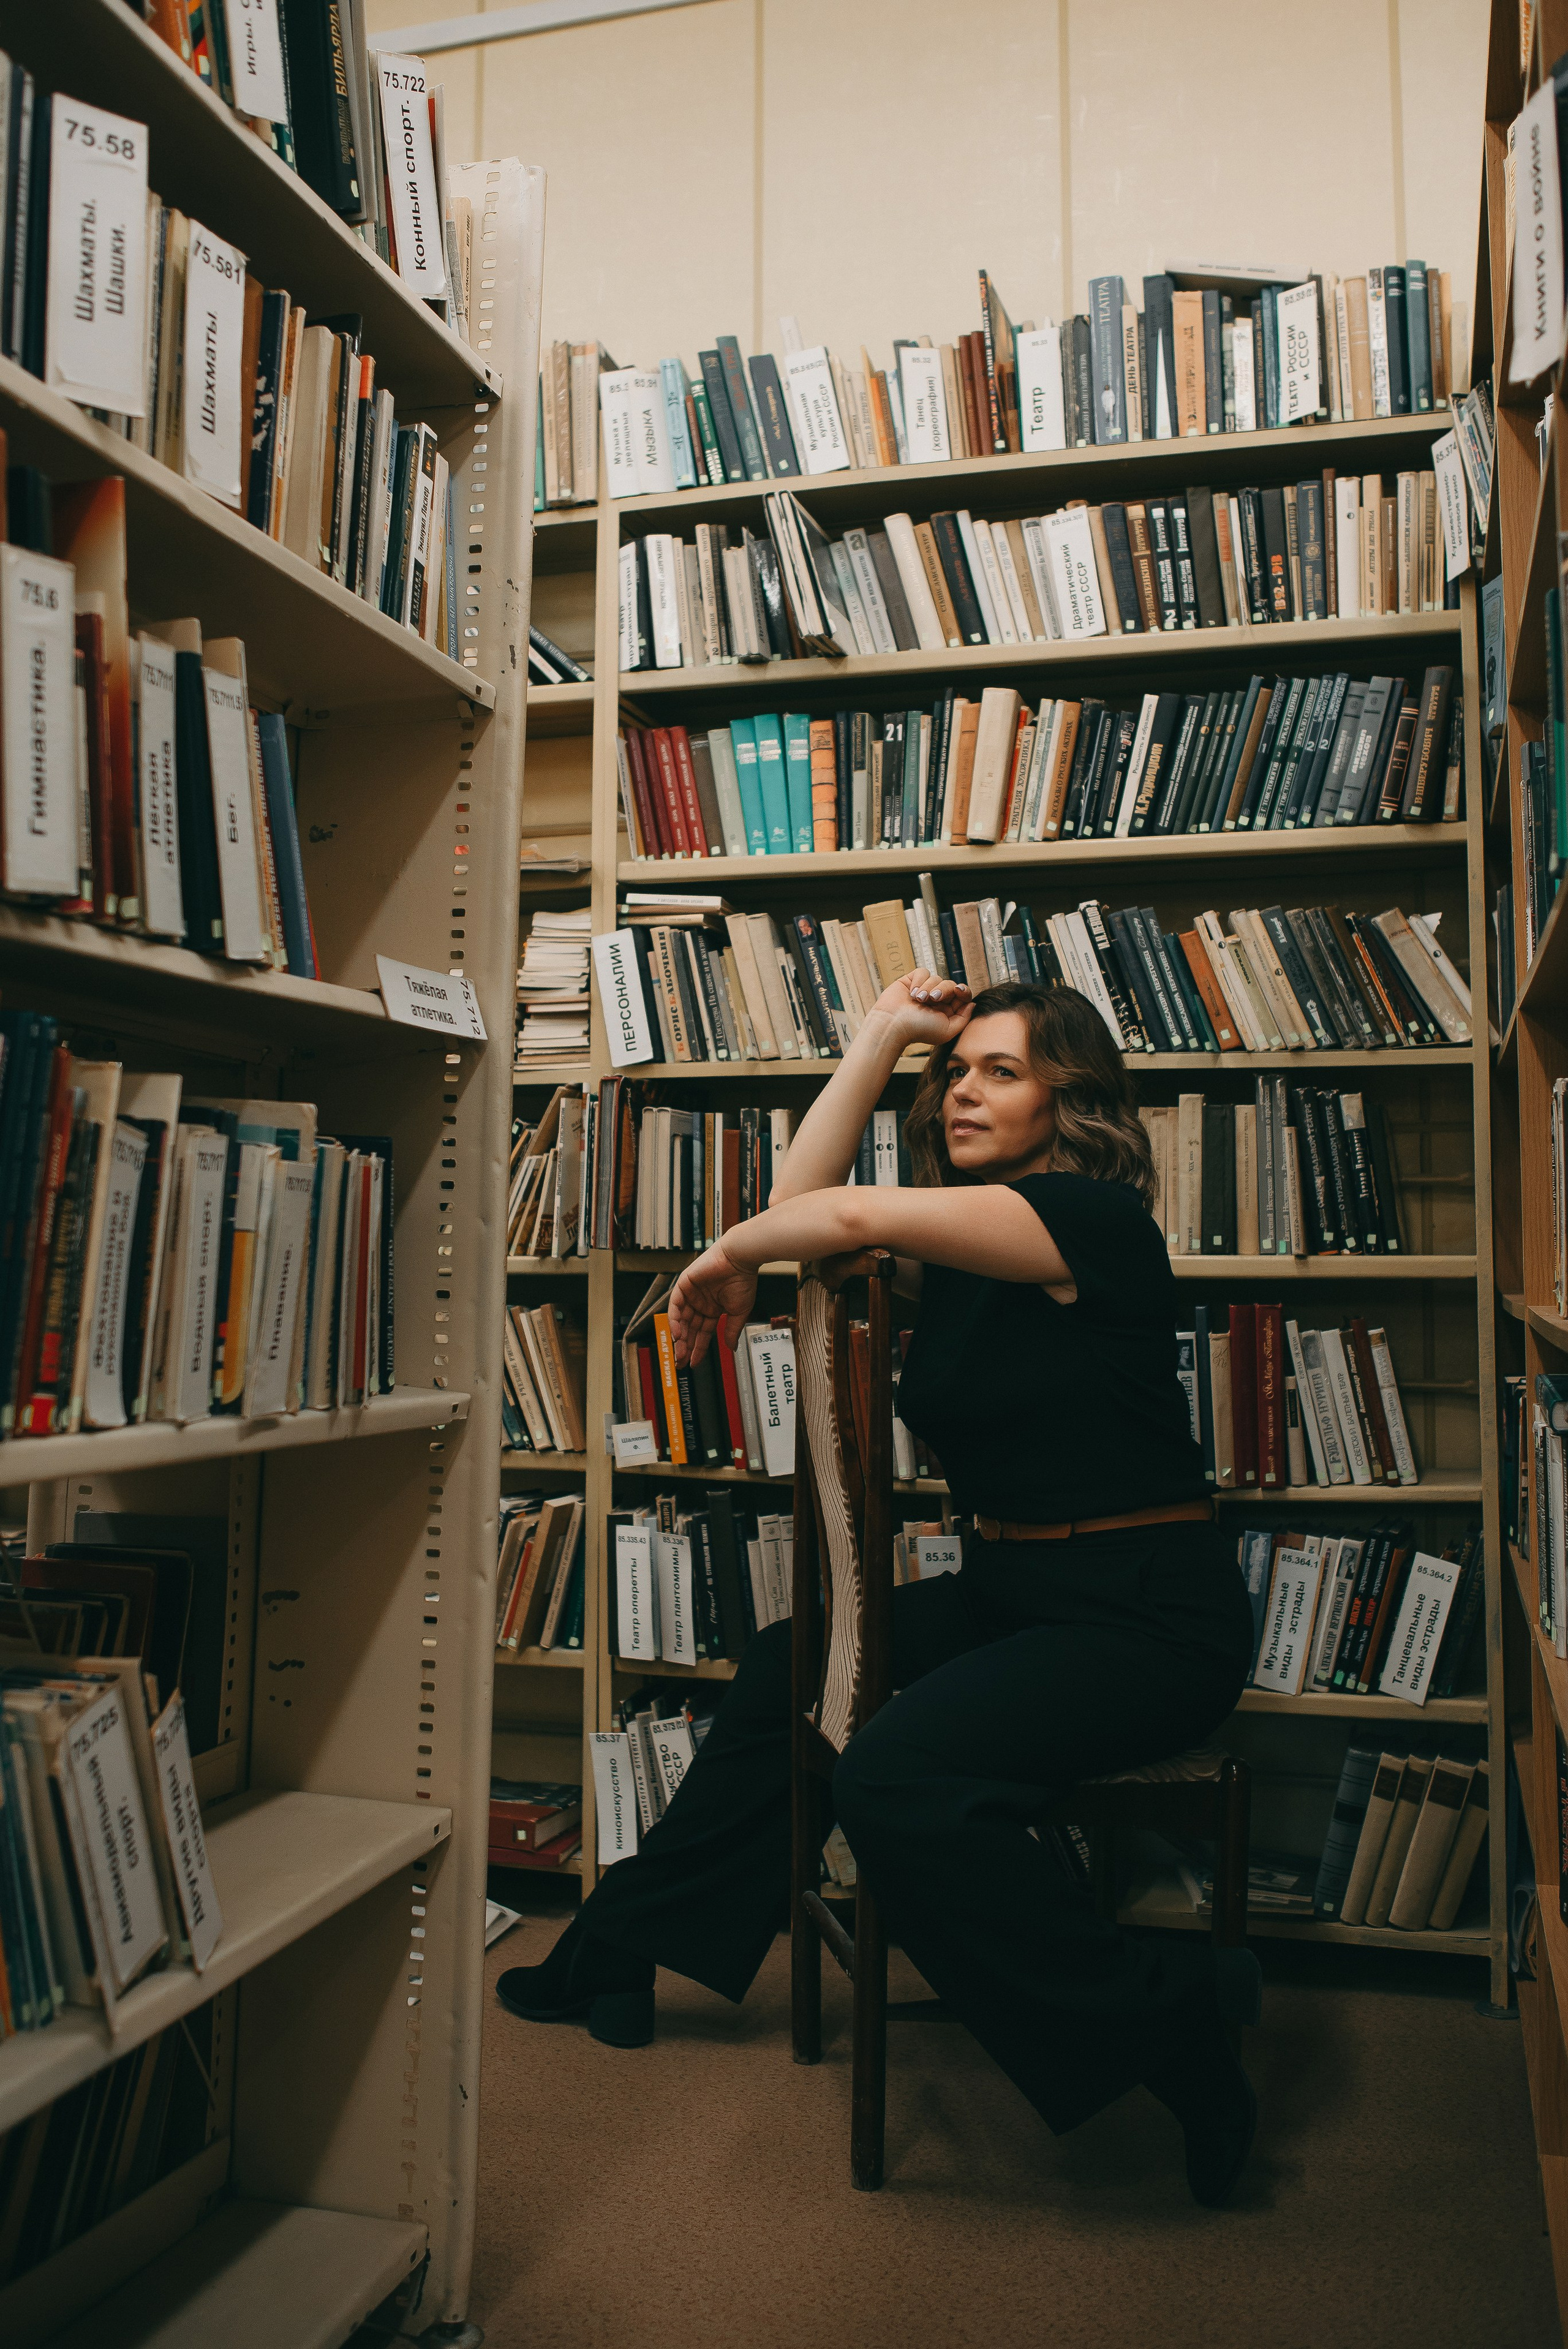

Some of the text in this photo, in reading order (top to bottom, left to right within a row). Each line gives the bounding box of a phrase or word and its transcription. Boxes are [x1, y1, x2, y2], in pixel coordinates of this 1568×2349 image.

[329, 4, 349, 97] БИЛЬЯРДА
[383, 71, 425, 93] 75.722
[64, 119, 135, 160] 75.58
[401, 100, 426, 270] Конный спорт.
[1530, 123, 1548, 342] Книги о войне
[74, 198, 96, 322] Шахматы.
[105, 224, 126, 315] Шашки.
[192, 240, 241, 284] 75.581
[1098, 282, 1110, 324] ТЕАТРА
[201, 311, 217, 435] Шахматы.
[1126, 326, 1137, 394] ДЕНЬ ТЕАТРА
[1298, 330, 1310, 368] СССР
[799, 393, 817, 451] Музыкальная
[812, 399, 826, 438] культура
[818, 384, 840, 448] России СССР
[915, 398, 925, 429] Танец
[926, 377, 941, 451] (хореография)
[1030, 386, 1046, 434] Театр
[622, 412, 632, 467] зрелищные
[1436, 440, 1457, 463] 85.374
[420, 486, 430, 515] Ласкер
[1443, 470, 1457, 560] Художественно-
[1032, 528, 1042, 556] МАЯКОВСКОГО
[1250, 551, 1259, 577] Портреты
[703, 559, 713, 607] зарубежного
[859, 555, 876, 595] ЖИЗНЬ ИСКУССТВЕ
[1060, 544, 1084, 630] Драматический
[1077, 562, 1096, 627] театр СССР
[1165, 559, 1175, 602] ВОЛКОНСКИЙ
[625, 601, 635, 667] зарубежных
[1268, 682, 1282, 720] ТОВСТОНОГОВ
[1272, 682, 1286, 725] ЗЕРКАЛО СЦЕНЫ
[1313, 679, 1328, 717] ТОВСТОНОГОВ
[1317, 680, 1333, 722] ЗЕРКАЛО СЦЕНЫ
[1327, 677, 1342, 715] ТОВСТОНОГОВ
[1330, 677, 1347, 720] ЗЕРКАЛО СЦЕНЫ
[28, 641, 47, 837] Гимнастика.
[1131, 703, 1153, 774] Реальность образность
[1265, 693, 1298, 806] ТОВСТОНОГОВ ЗЕРКАЛО СЦЕНЫ
[1279, 693, 1315, 807] ТОВСТОНОГОВ ЗЕРКАЛО СЦЕНЫ
[938, 763, 946, 799] ПОЭТИЧЕСКИЙ
[1011, 739, 1031, 827] ТРАГЕДИЯ ХУДОЖНИКА
[1050, 751, 1068, 818] РАССКАЗЫ РУССКИХ
[1169, 783, 1180, 805] РУССКОГО
[227, 791, 238, 843] Бег.
[697, 935, 717, 1006] На сцене жизни
[932, 932, 943, 967] Ефремов
[1144, 950, 1163, 991] ПЕРЕГОНЕЦ
[1355, 957, 1369, 983] ОСТРОВА
[404, 975, 448, 1000] Тяжёлая
[461, 981, 480, 1035] 75.712
[608, 943, 637, 1052] ПЕРСОНАЛИИ
[657, 930, 685, 1052] БОРИС БАБОЧКИН
[807, 946, 835, 1033] Владимир Зельдин
[1158, 951, 1193, 1036] АЛЕКСАНДРА ПЕРЕГОНЕЦ
[410, 1004, 457, 1025] атлетика.
[1158, 992, 1177, 1036] АЛЕКСАНДРА
[1262, 1085, 1272, 1118] профессии
[1303, 1103, 1315, 1135] ТЕАТРЕ
[1263, 1125, 1272, 1169] Размышления
[1325, 1105, 1344, 1203] МУЗЫКАЛЬНОМ ТЕАТРЕ
[742, 1151, 753, 1203] Театральная
[1266, 1212, 1275, 1240] Евгений
[1281, 1177, 1291, 1242] Евгений Нестеренко
[268, 1243, 293, 1360] Плавание.
[514, 1363, 527, 1397] УЧЕБНОЕ
[660, 1330, 673, 1387] МАСКА ДУША
[760, 1352, 781, 1427] Балетный
[780, 1363, 795, 1404] театр
[1311, 1373, 1330, 1414] НУРИЕВ
[1353, 1374, 1366, 1413] Александр
[679, 1377, 696, 1450] ФЕДОР ШАЛЯПИН
[1337, 1372, 1364, 1466] СОВЕТСКИЙ БАЛЕТНЫЙ ТЕАТР
[621, 1435, 649, 1444] Шаляпин
[617, 1534, 647, 1545] 85.335.43
[662, 1535, 685, 1546] 85.336
[704, 1545, 712, 1575] СТУПЕНЬКАМ
[925, 1552, 956, 1562] 85.36
[1281, 1553, 1319, 1569] 85.364.1
[1416, 1564, 1453, 1583] 85.364.2
[629, 1557, 641, 1651] Театр оперетты
[671, 1546, 684, 1654] Театр пантомимы
[1349, 1597, 1362, 1626] ВИКТОР
[1263, 1581, 1290, 1670] Музыкальные
[1280, 1580, 1306, 1680] виды эстрады
[1321, 1581, 1348, 1673] АЛЕКСАНДР ВЕРТИНСКИЙ
[1392, 1593, 1426, 1686] Танцевальные
[1409, 1598, 1442, 1691] виды эстрады
[596, 1733, 620, 1743] 85.37
[630, 1733, 641, 1768] ОТТЕПЕЛИ
[609, 1758, 624, 1850] киноискусство
[115, 1797, 140, 1869] спорт.
[176, 1839, 205, 1927] Другие
